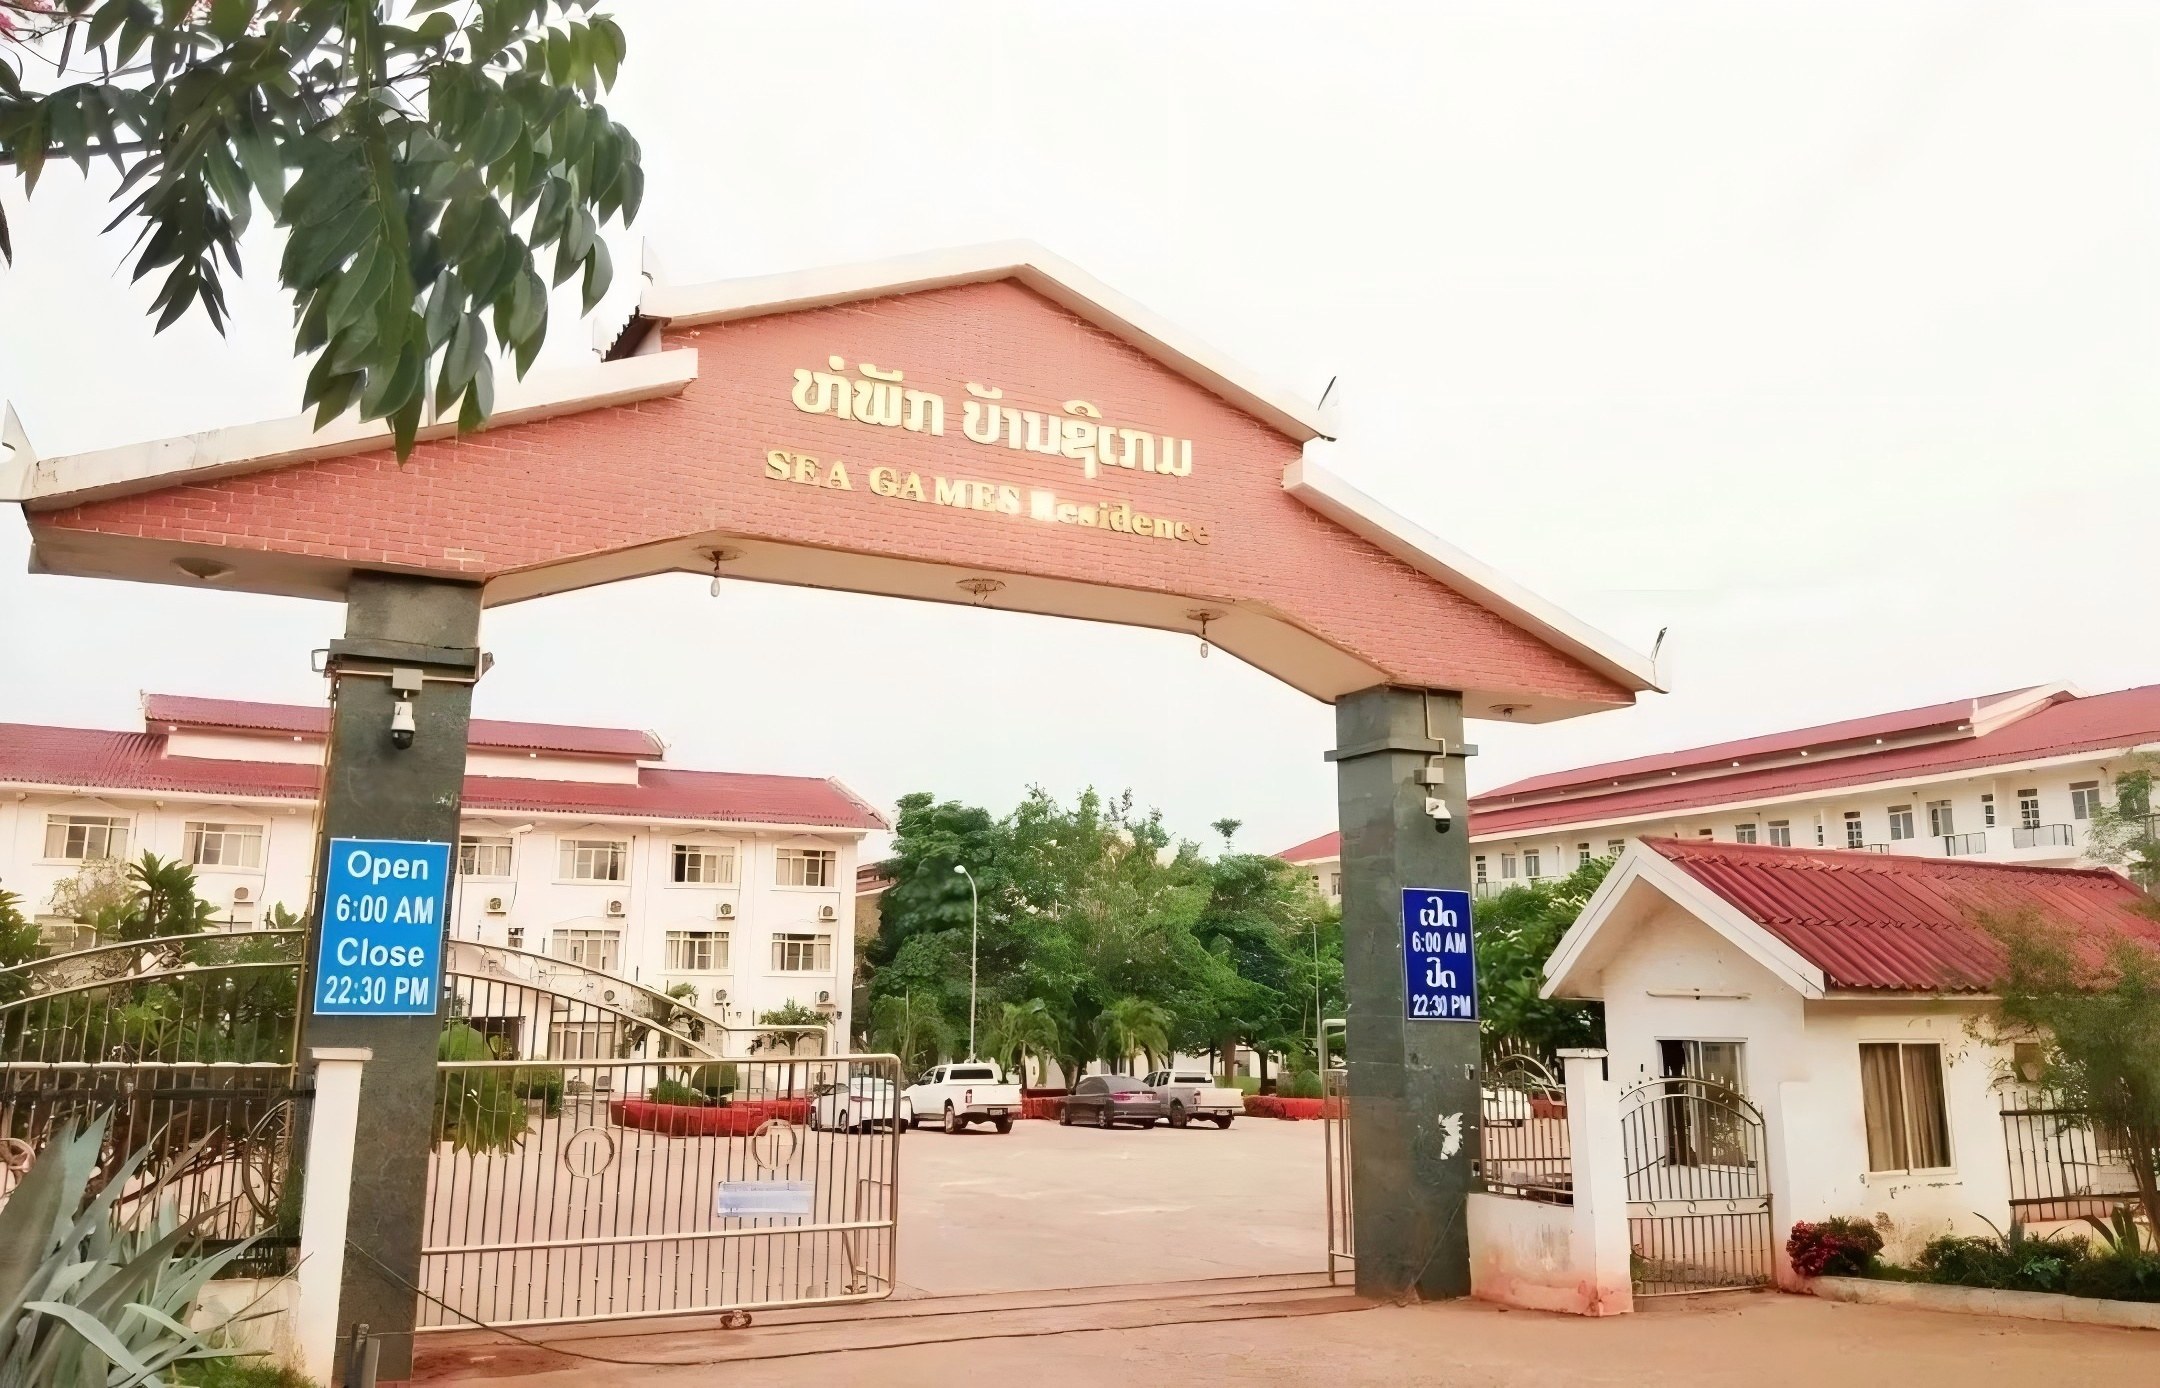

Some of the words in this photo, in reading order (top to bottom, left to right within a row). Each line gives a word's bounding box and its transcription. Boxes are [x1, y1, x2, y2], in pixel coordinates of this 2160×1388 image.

[765, 449, 853, 492] SEA
[869, 466, 1021, 516] GAMES
[1030, 489, 1211, 546] esidence
[347, 850, 428, 885] Open
[336, 893, 388, 924] 6:00
[393, 896, 434, 925] AM
[337, 937, 425, 967] Close
[1412, 931, 1441, 953] 6:00
[1445, 932, 1467, 954] AM
[323, 975, 387, 1005] 22:30
[394, 976, 429, 1006] PM
[1451, 994, 1471, 1017] PM
